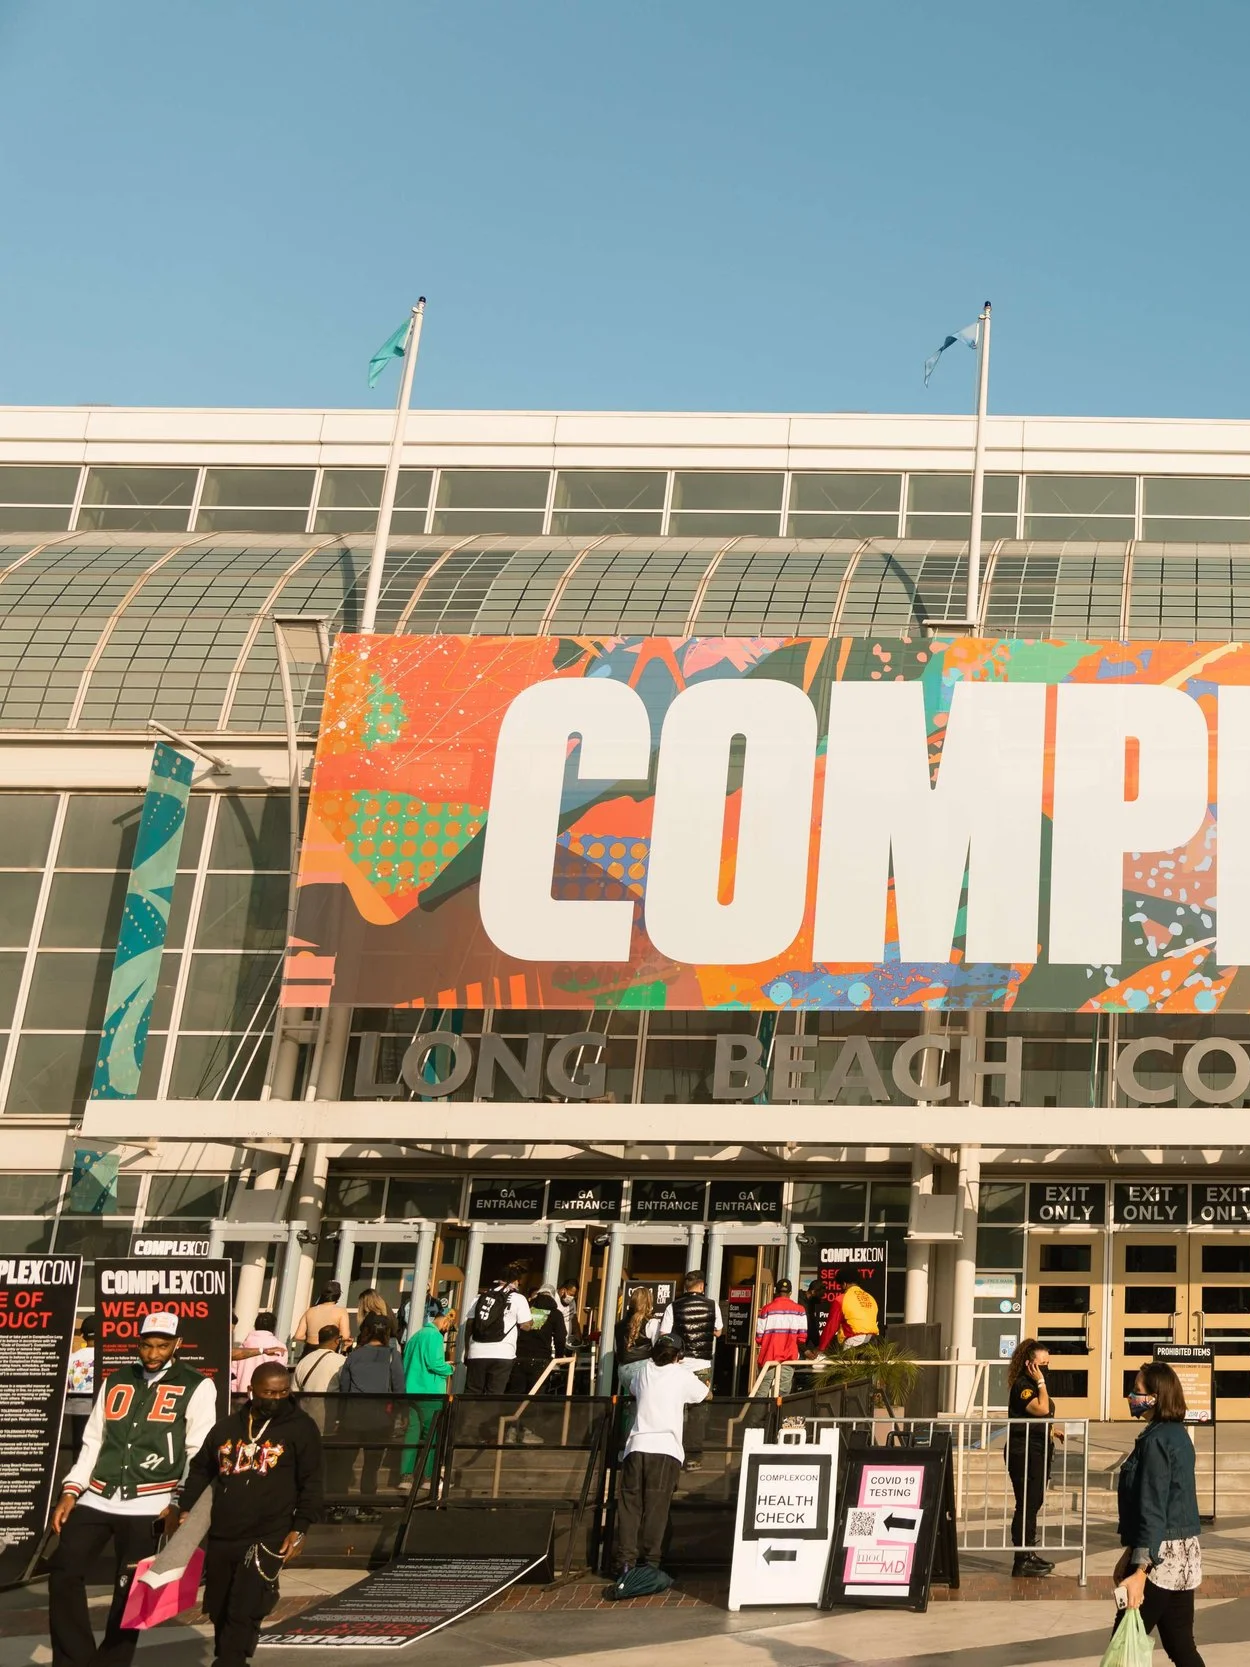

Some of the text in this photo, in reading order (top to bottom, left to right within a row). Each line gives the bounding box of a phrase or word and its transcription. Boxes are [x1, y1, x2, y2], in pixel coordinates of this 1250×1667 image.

[353, 1031, 609, 1099] LONG
[712, 1033, 1024, 1103] BEACH
[500, 1189, 516, 1199] GA
[578, 1190, 594, 1200] GA
[660, 1190, 677, 1200] GA
[738, 1191, 755, 1201] GA
[1045, 1186, 1090, 1202] EXIT
[1129, 1187, 1173, 1202] EXIT
[1206, 1187, 1250, 1202] EXIT
[476, 1200, 538, 1210] ENTRANCE
[554, 1200, 616, 1210] ENTRANCE
[637, 1201, 699, 1211] ENTRANCE
[715, 1201, 777, 1212] ENTRANCE
[1039, 1205, 1094, 1221] ONLY
[1123, 1205, 1178, 1221] ONLY
[134, 1240, 210, 1256] COMPLEXCO
[821, 1247, 884, 1263] COMPLEXCON
[101, 1270, 226, 1295] COMPLEXCON
[14, 1291, 44, 1309] OF
[102, 1301, 209, 1318] WEAPONS
[102, 1321, 141, 1338] POL
[1157, 1347, 1211, 1356] PROHIBITED ITEMS
[140, 1453, 165, 1471] 21
[759, 1474, 819, 1482] COMPLEXCON
[870, 1476, 915, 1485] COVID 19
[869, 1488, 911, 1497] TESTING
[757, 1495, 814, 1507] HEALTH
[755, 1512, 806, 1524] CHECK
